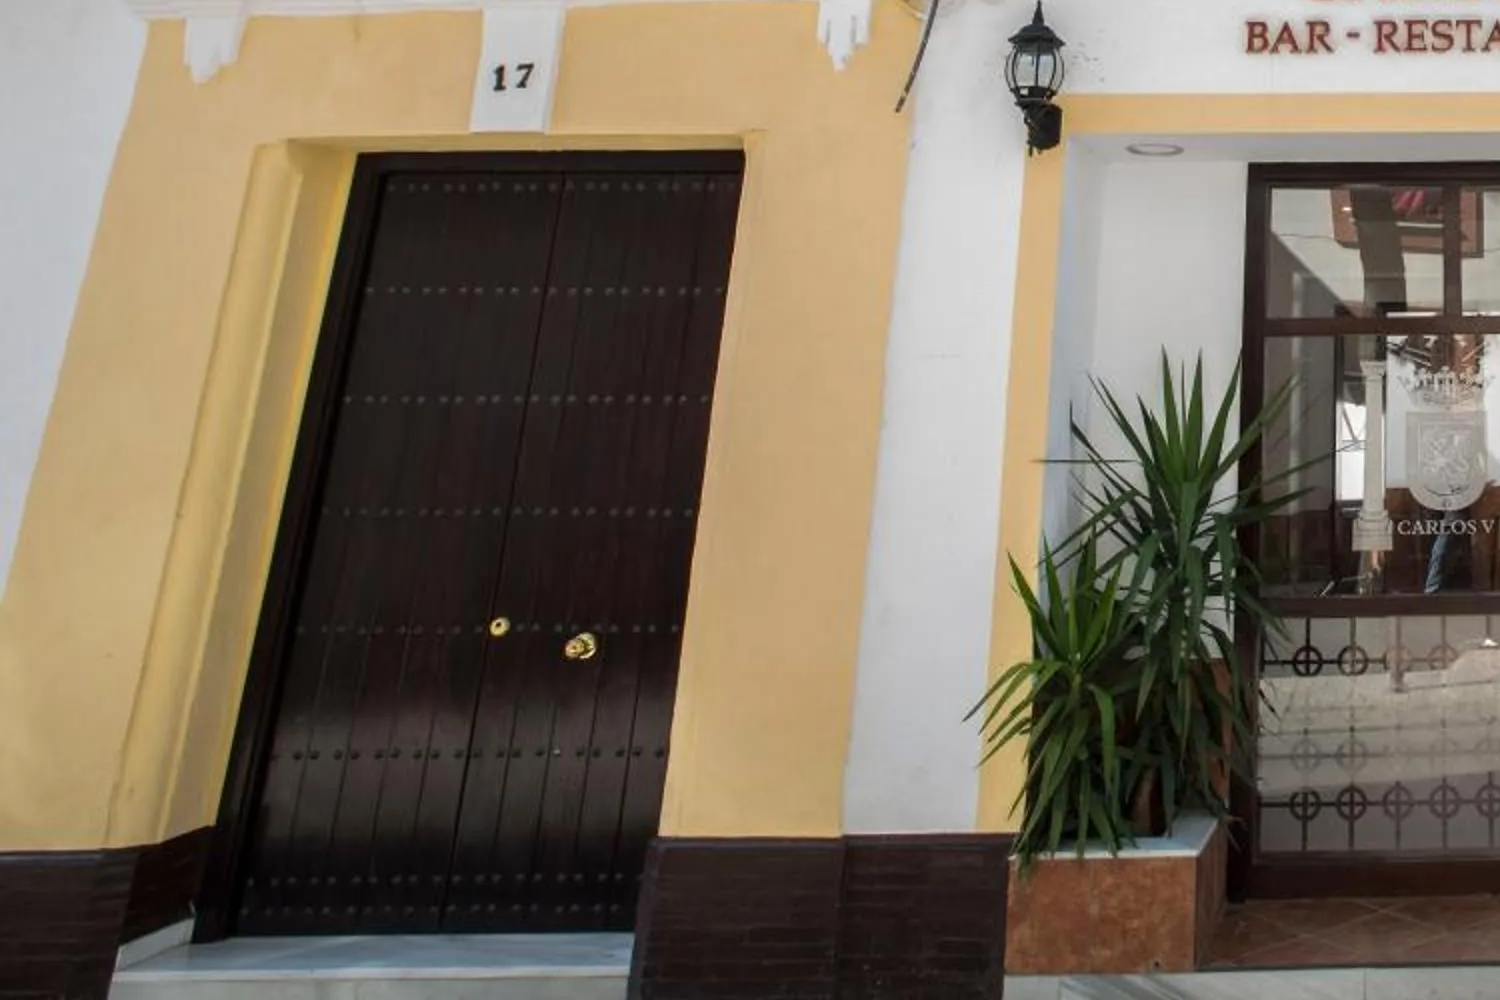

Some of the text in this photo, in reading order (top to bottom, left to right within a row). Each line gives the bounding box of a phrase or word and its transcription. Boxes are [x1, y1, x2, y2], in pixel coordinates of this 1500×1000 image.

[1245, 19, 1335, 55] BAR
[492, 62, 535, 93] 17
[1397, 519, 1496, 536] CARLOS V
